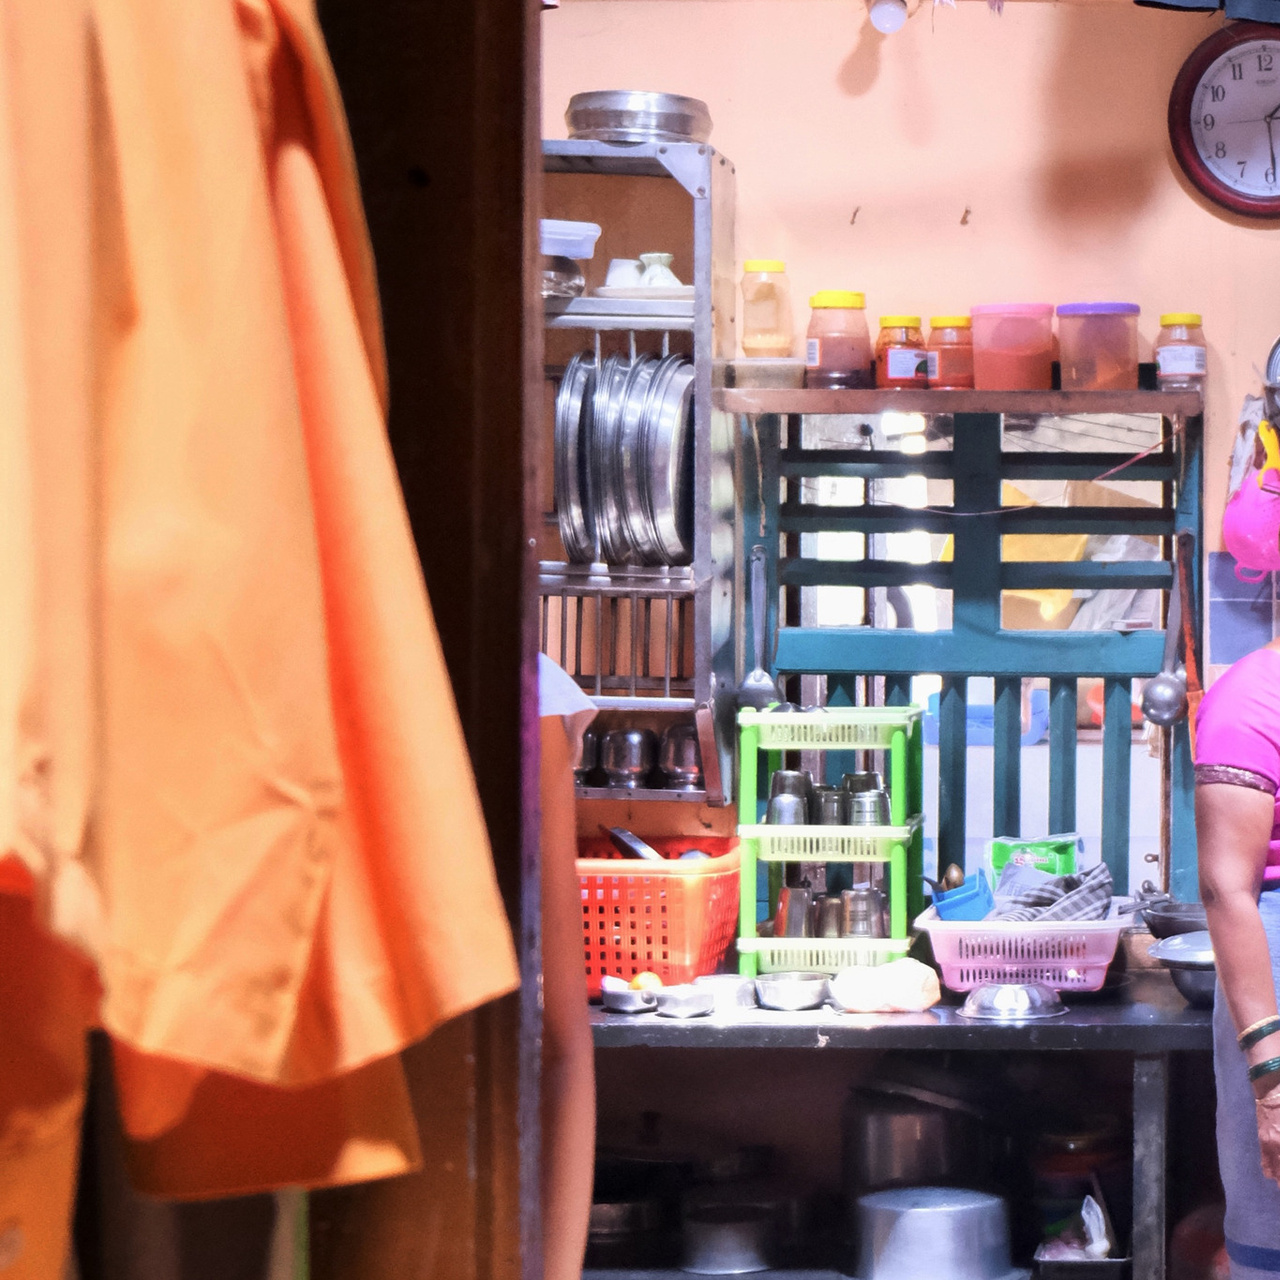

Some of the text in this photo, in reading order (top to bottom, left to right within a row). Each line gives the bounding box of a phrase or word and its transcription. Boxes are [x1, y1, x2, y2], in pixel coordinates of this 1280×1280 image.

[1231, 63, 1244, 80] 11
[1257, 54, 1273, 72] 12
[1211, 85, 1226, 102] 10
[1203, 114, 1215, 131] 9
[1215, 142, 1227, 158] 8
[1237, 161, 1248, 178] 7
[1265, 167, 1276, 184] 6
